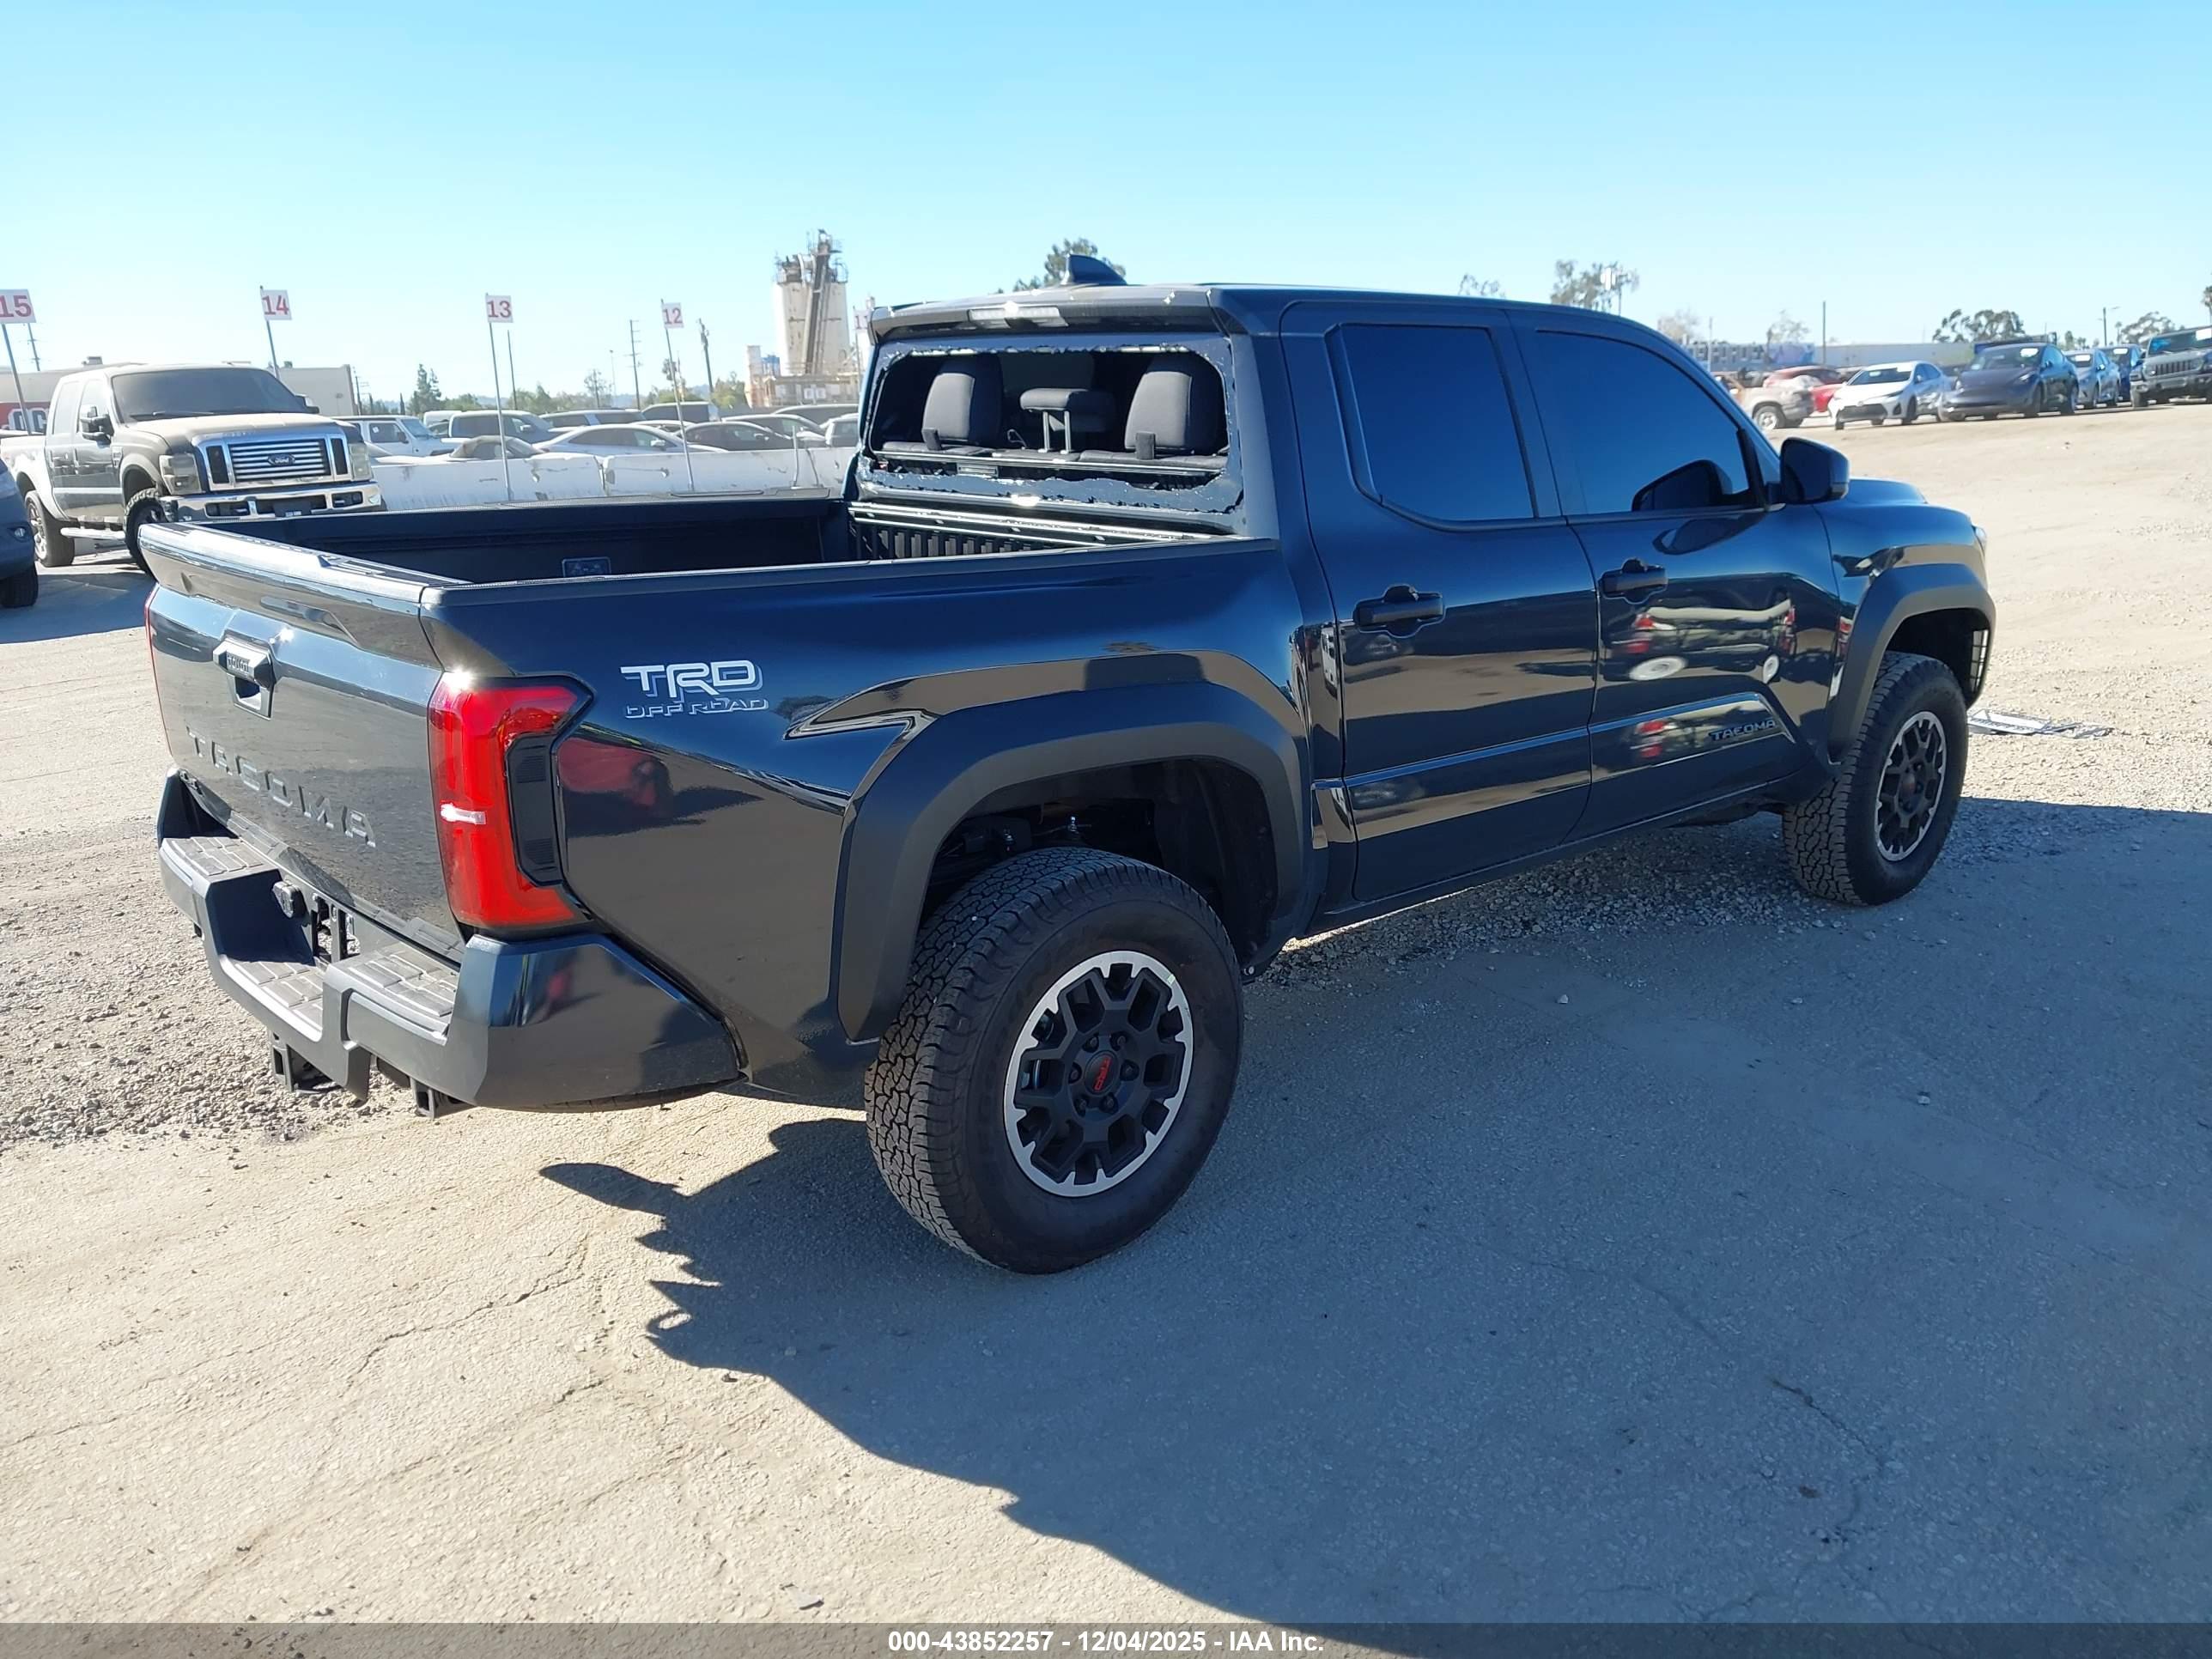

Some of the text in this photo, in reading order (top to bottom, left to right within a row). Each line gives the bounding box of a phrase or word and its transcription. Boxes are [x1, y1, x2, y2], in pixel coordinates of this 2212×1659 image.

[0, 295, 32, 318] 15
[262, 295, 289, 315] 14
[487, 300, 512, 318] 13
[663, 307, 683, 325] 12
[620, 659, 762, 701] TRD
[624, 696, 769, 719] OFF ROAD
[1709, 717, 1777, 740] TACOMA
[185, 724, 377, 848] TACOMA
[1094, 1056, 1112, 1091] TRD
